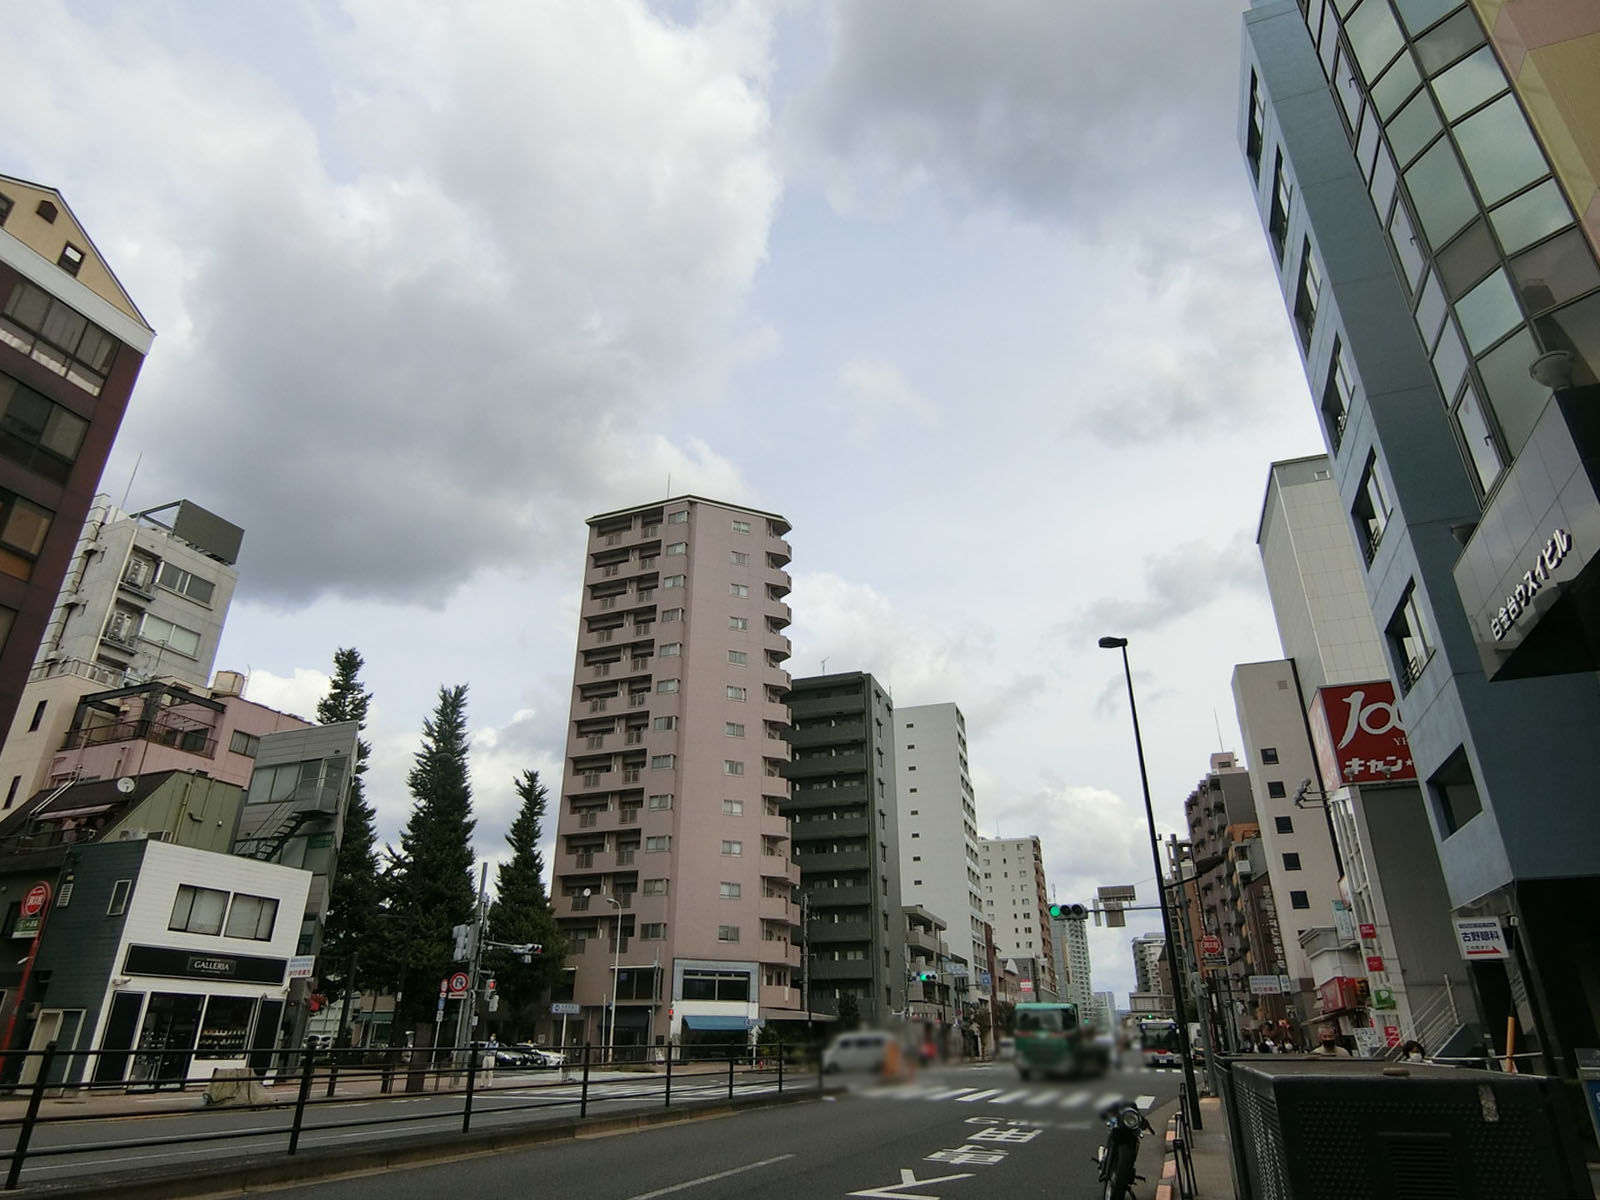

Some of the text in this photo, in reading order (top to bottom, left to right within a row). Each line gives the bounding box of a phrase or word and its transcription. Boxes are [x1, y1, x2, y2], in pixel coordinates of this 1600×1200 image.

[1491, 529, 1568, 641] 白金台ウスイビル
[1460, 930, 1500, 943] 古野眼科
[194, 960, 229, 971] GALLERIA
